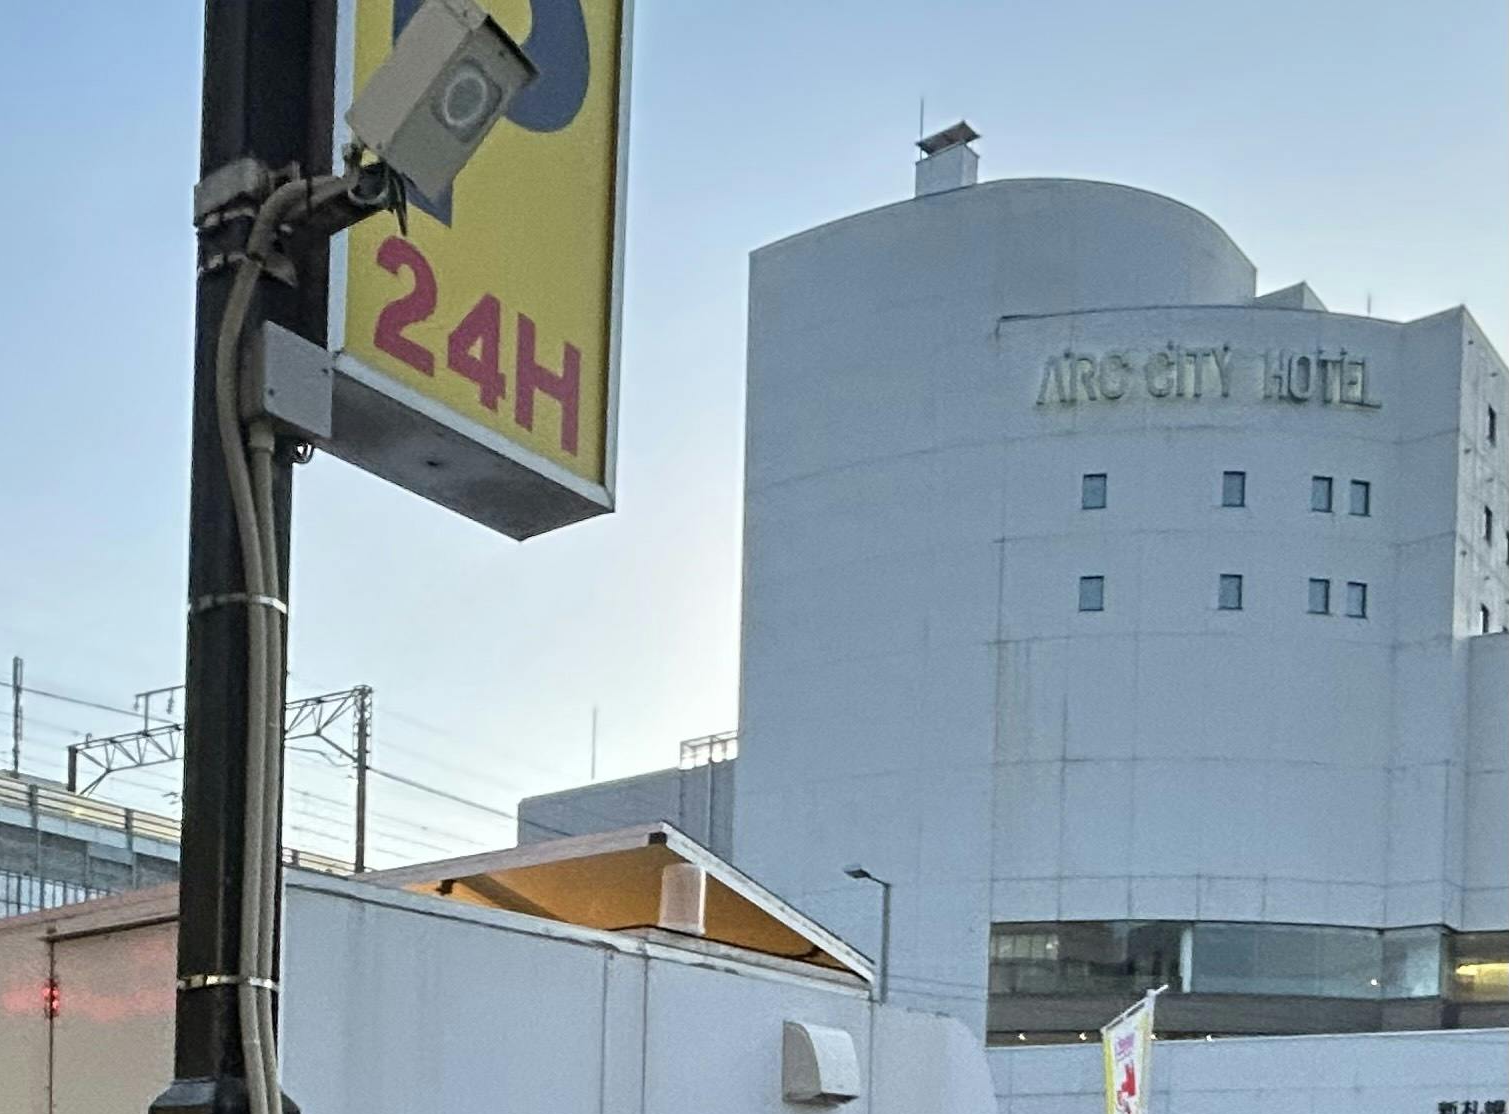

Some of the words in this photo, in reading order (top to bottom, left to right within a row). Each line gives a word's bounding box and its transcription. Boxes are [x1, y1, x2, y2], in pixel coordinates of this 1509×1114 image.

[373, 235, 582, 457] 24H
[1036, 351, 1130, 405] ARC
[1143, 345, 1231, 399] CITY
[1262, 350, 1382, 409] HOTEL
